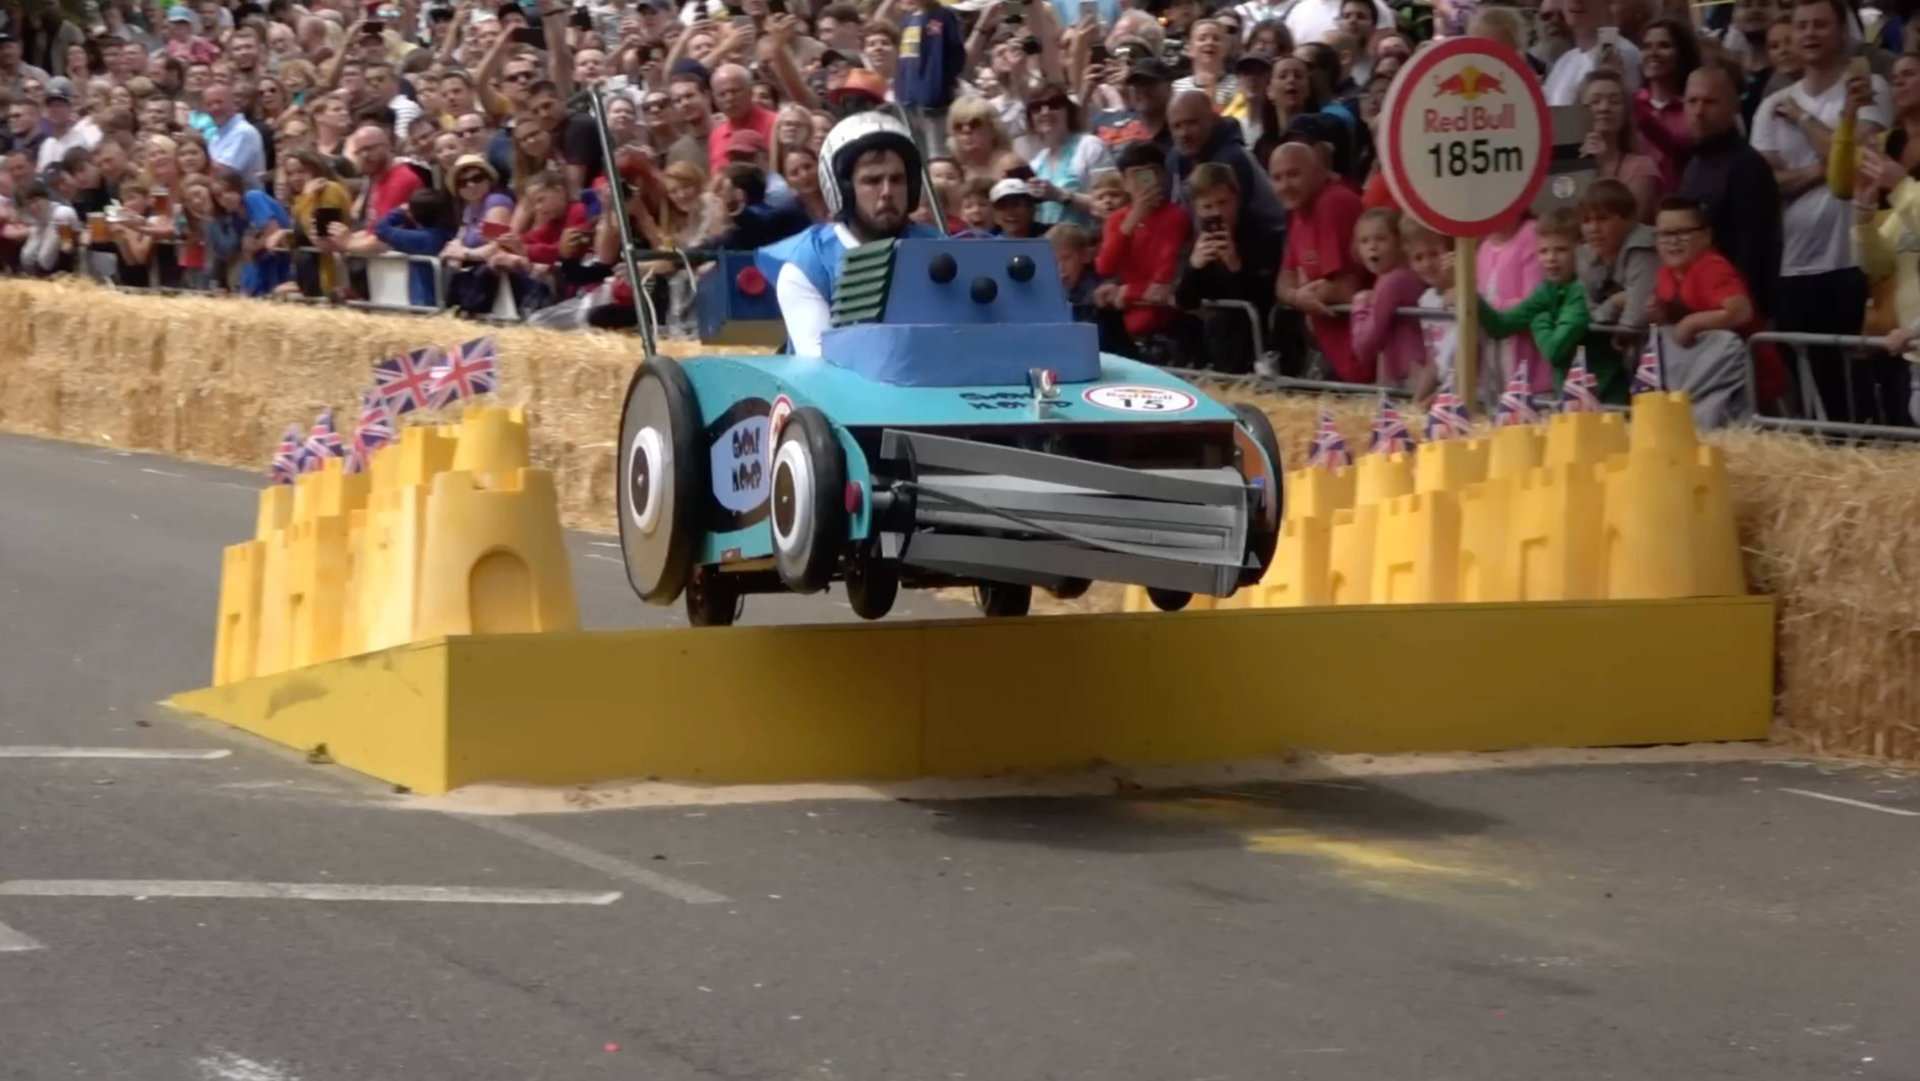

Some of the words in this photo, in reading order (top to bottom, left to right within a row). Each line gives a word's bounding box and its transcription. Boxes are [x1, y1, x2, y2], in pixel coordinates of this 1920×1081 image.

[1424, 104, 1468, 133] Red
[1473, 103, 1516, 131] Bull
[1428, 138, 1523, 178] 185m
[1120, 397, 1165, 410] 15
